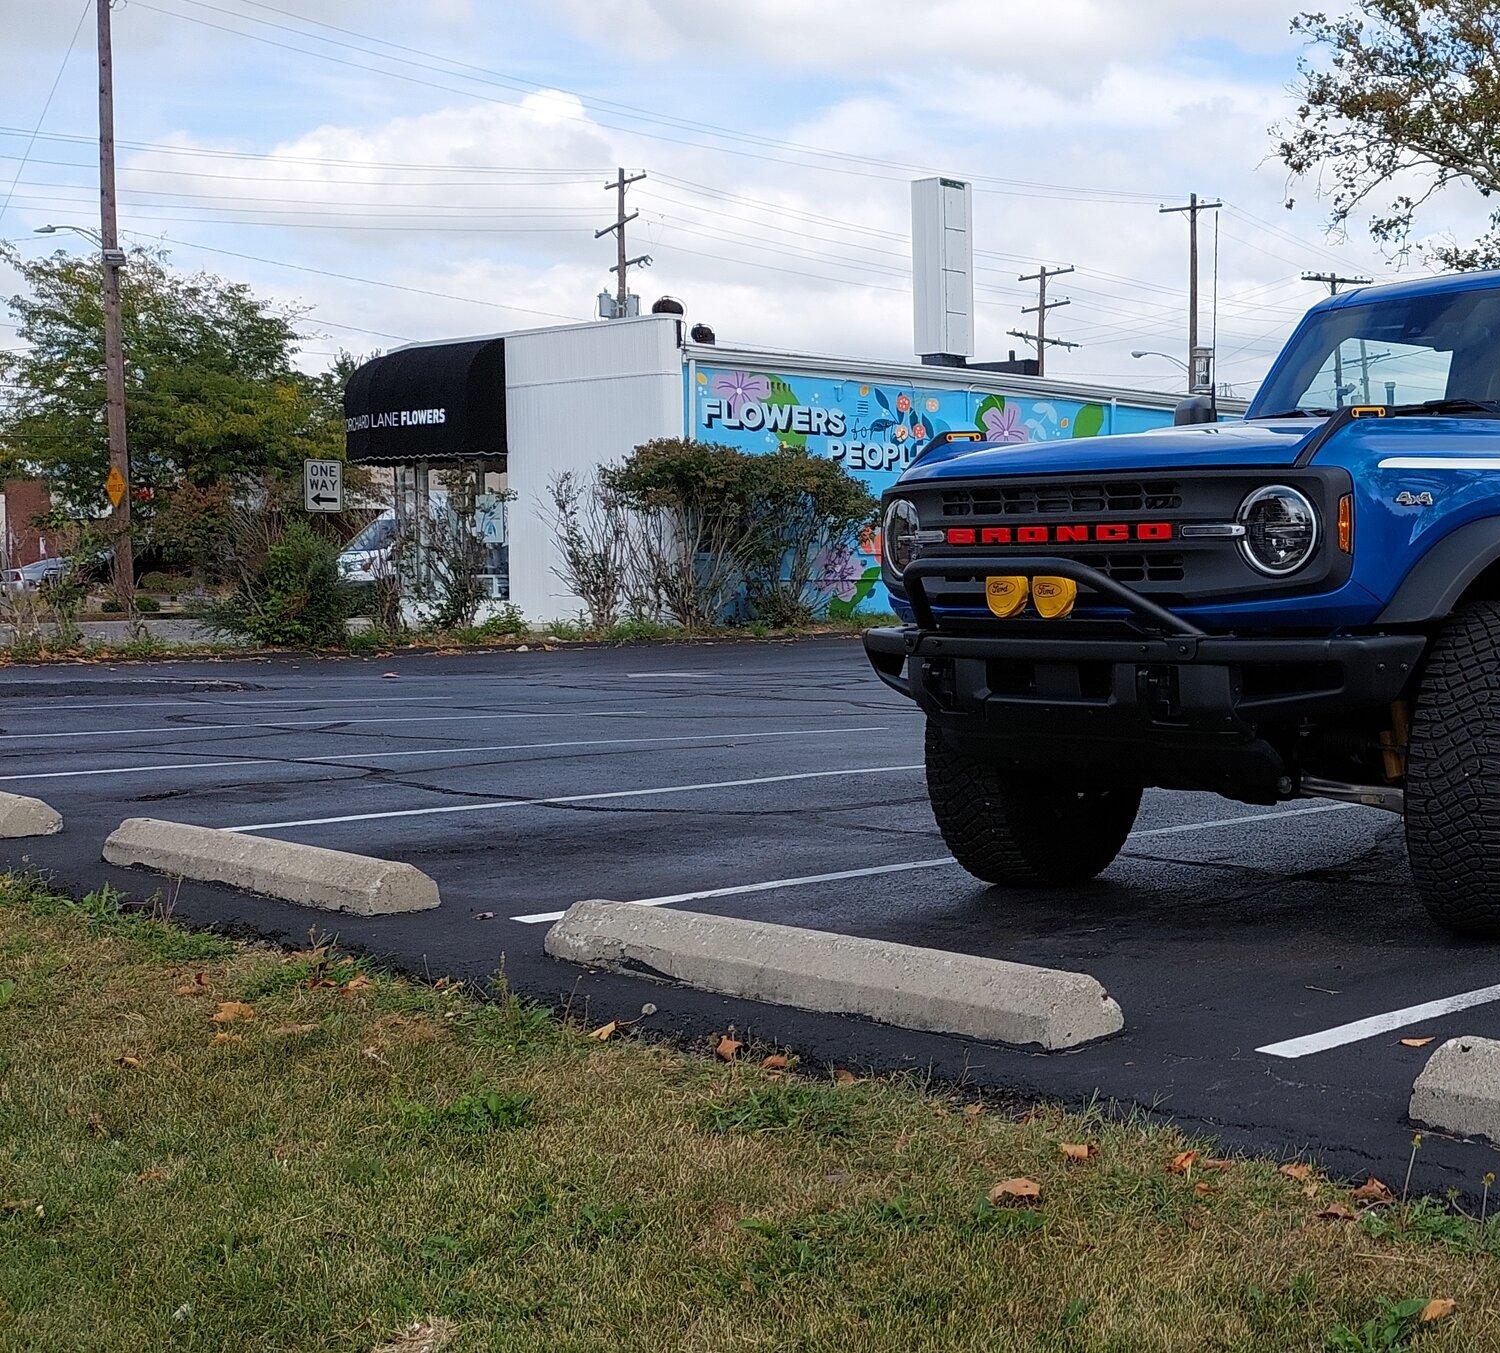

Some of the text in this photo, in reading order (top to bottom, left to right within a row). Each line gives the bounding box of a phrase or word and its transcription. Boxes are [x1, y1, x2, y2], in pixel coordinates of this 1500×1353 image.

[371, 412, 400, 428] LANE
[400, 408, 446, 426] FLOWERS
[701, 398, 847, 437] FLOWERS
[311, 464, 337, 477] ONE
[309, 478, 338, 491] WAY
[1396, 491, 1433, 505] 4x4
[947, 523, 1173, 544] BRONCO
[991, 582, 1009, 594] Ford
[1037, 584, 1055, 595] Ford
